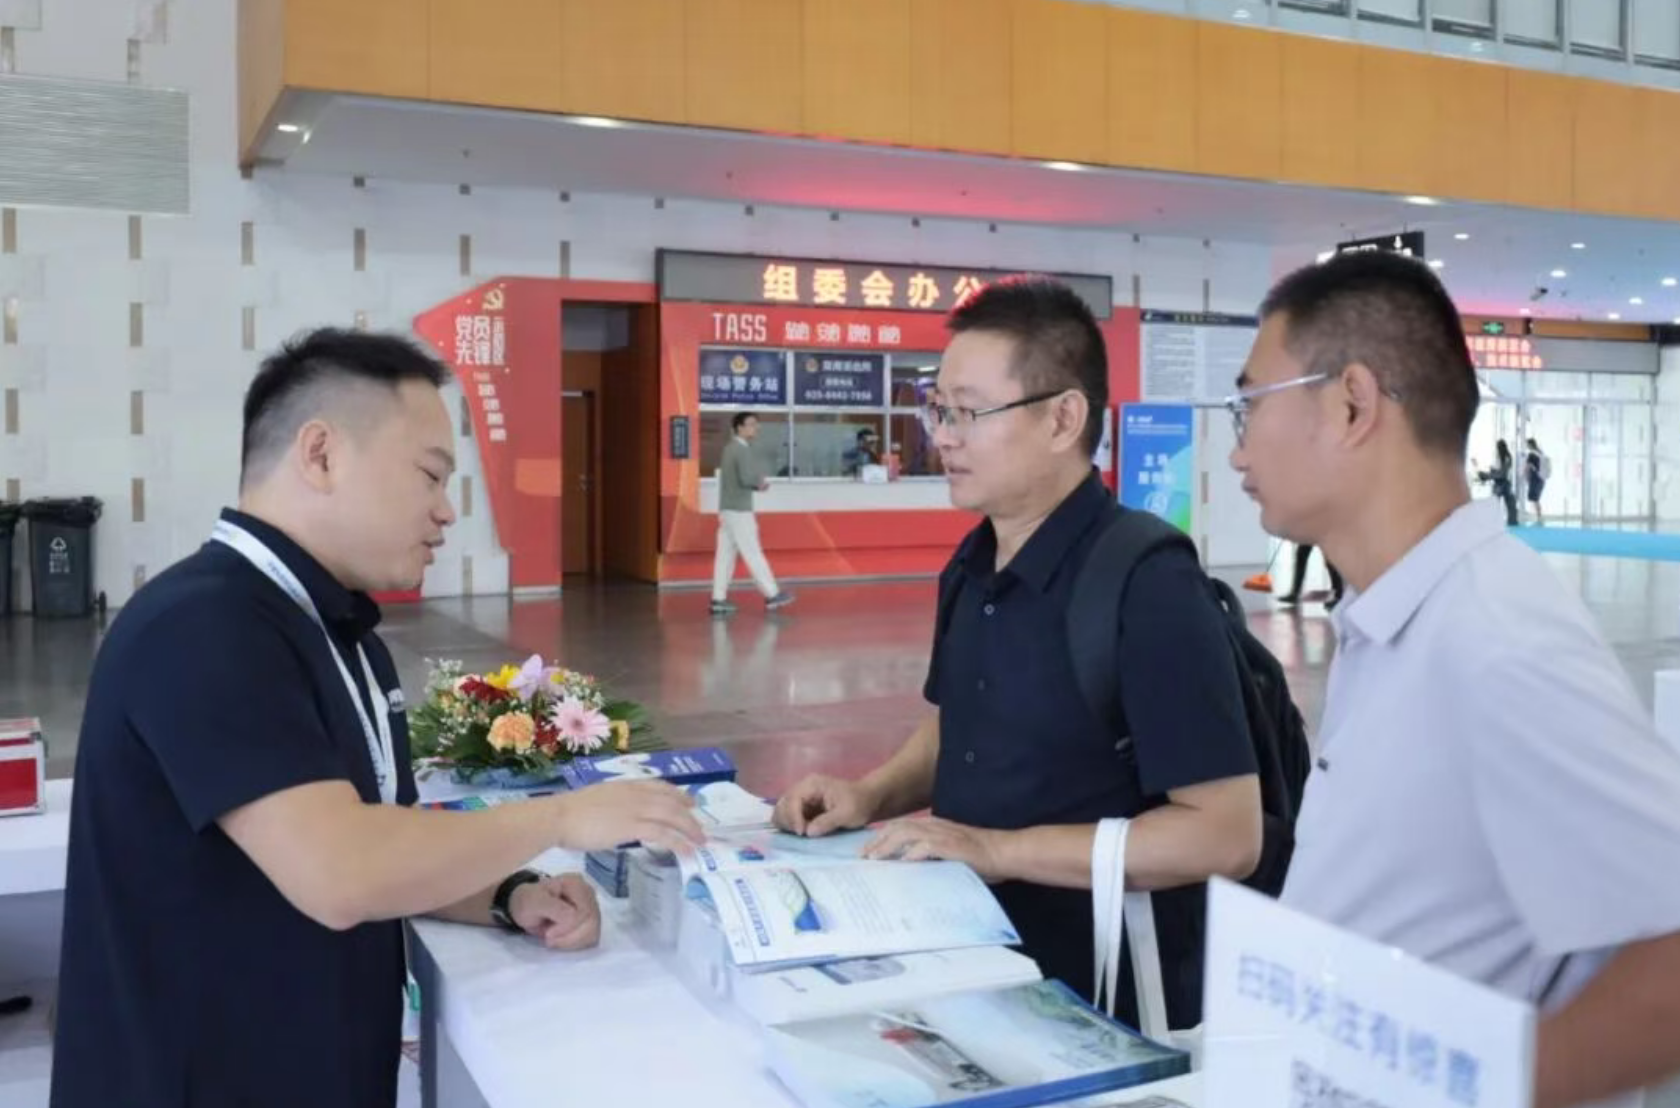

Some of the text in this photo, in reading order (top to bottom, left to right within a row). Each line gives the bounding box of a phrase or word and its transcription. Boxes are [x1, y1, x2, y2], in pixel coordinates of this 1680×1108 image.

[455, 315, 490, 341] 党员
[712, 312, 767, 342] TASS
[455, 340, 490, 365] 先锋
[701, 375, 779, 392] 现场警务站
